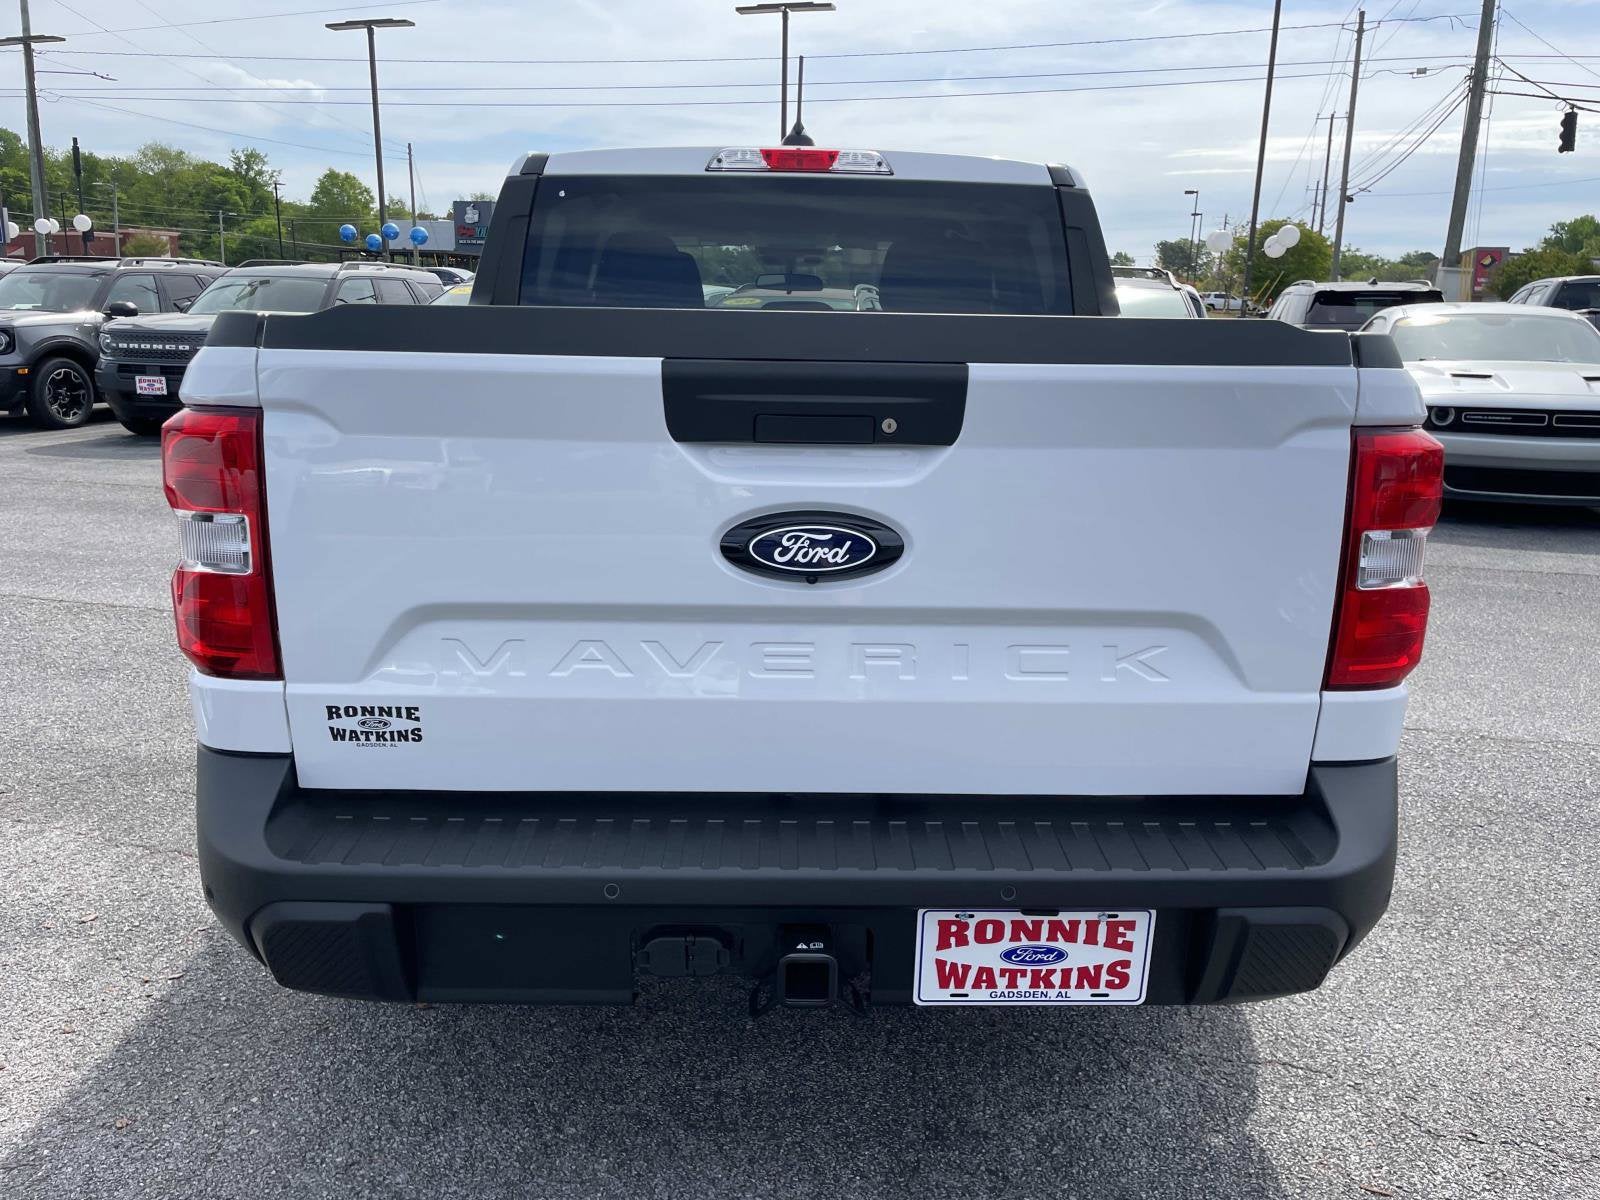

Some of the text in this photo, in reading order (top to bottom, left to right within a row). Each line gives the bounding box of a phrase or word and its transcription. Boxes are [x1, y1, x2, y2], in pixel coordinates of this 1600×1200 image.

[773, 531, 850, 564] Ford
[441, 637, 1170, 683] MAVERICK
[325, 705, 421, 722] RONNIE
[328, 726, 423, 742] WATKINS
[935, 919, 1137, 953] RONNIE
[1011, 947, 1058, 962] Ford
[934, 957, 1132, 990] WATKINS
[989, 990, 1071, 1000] GADSDEN, AL
